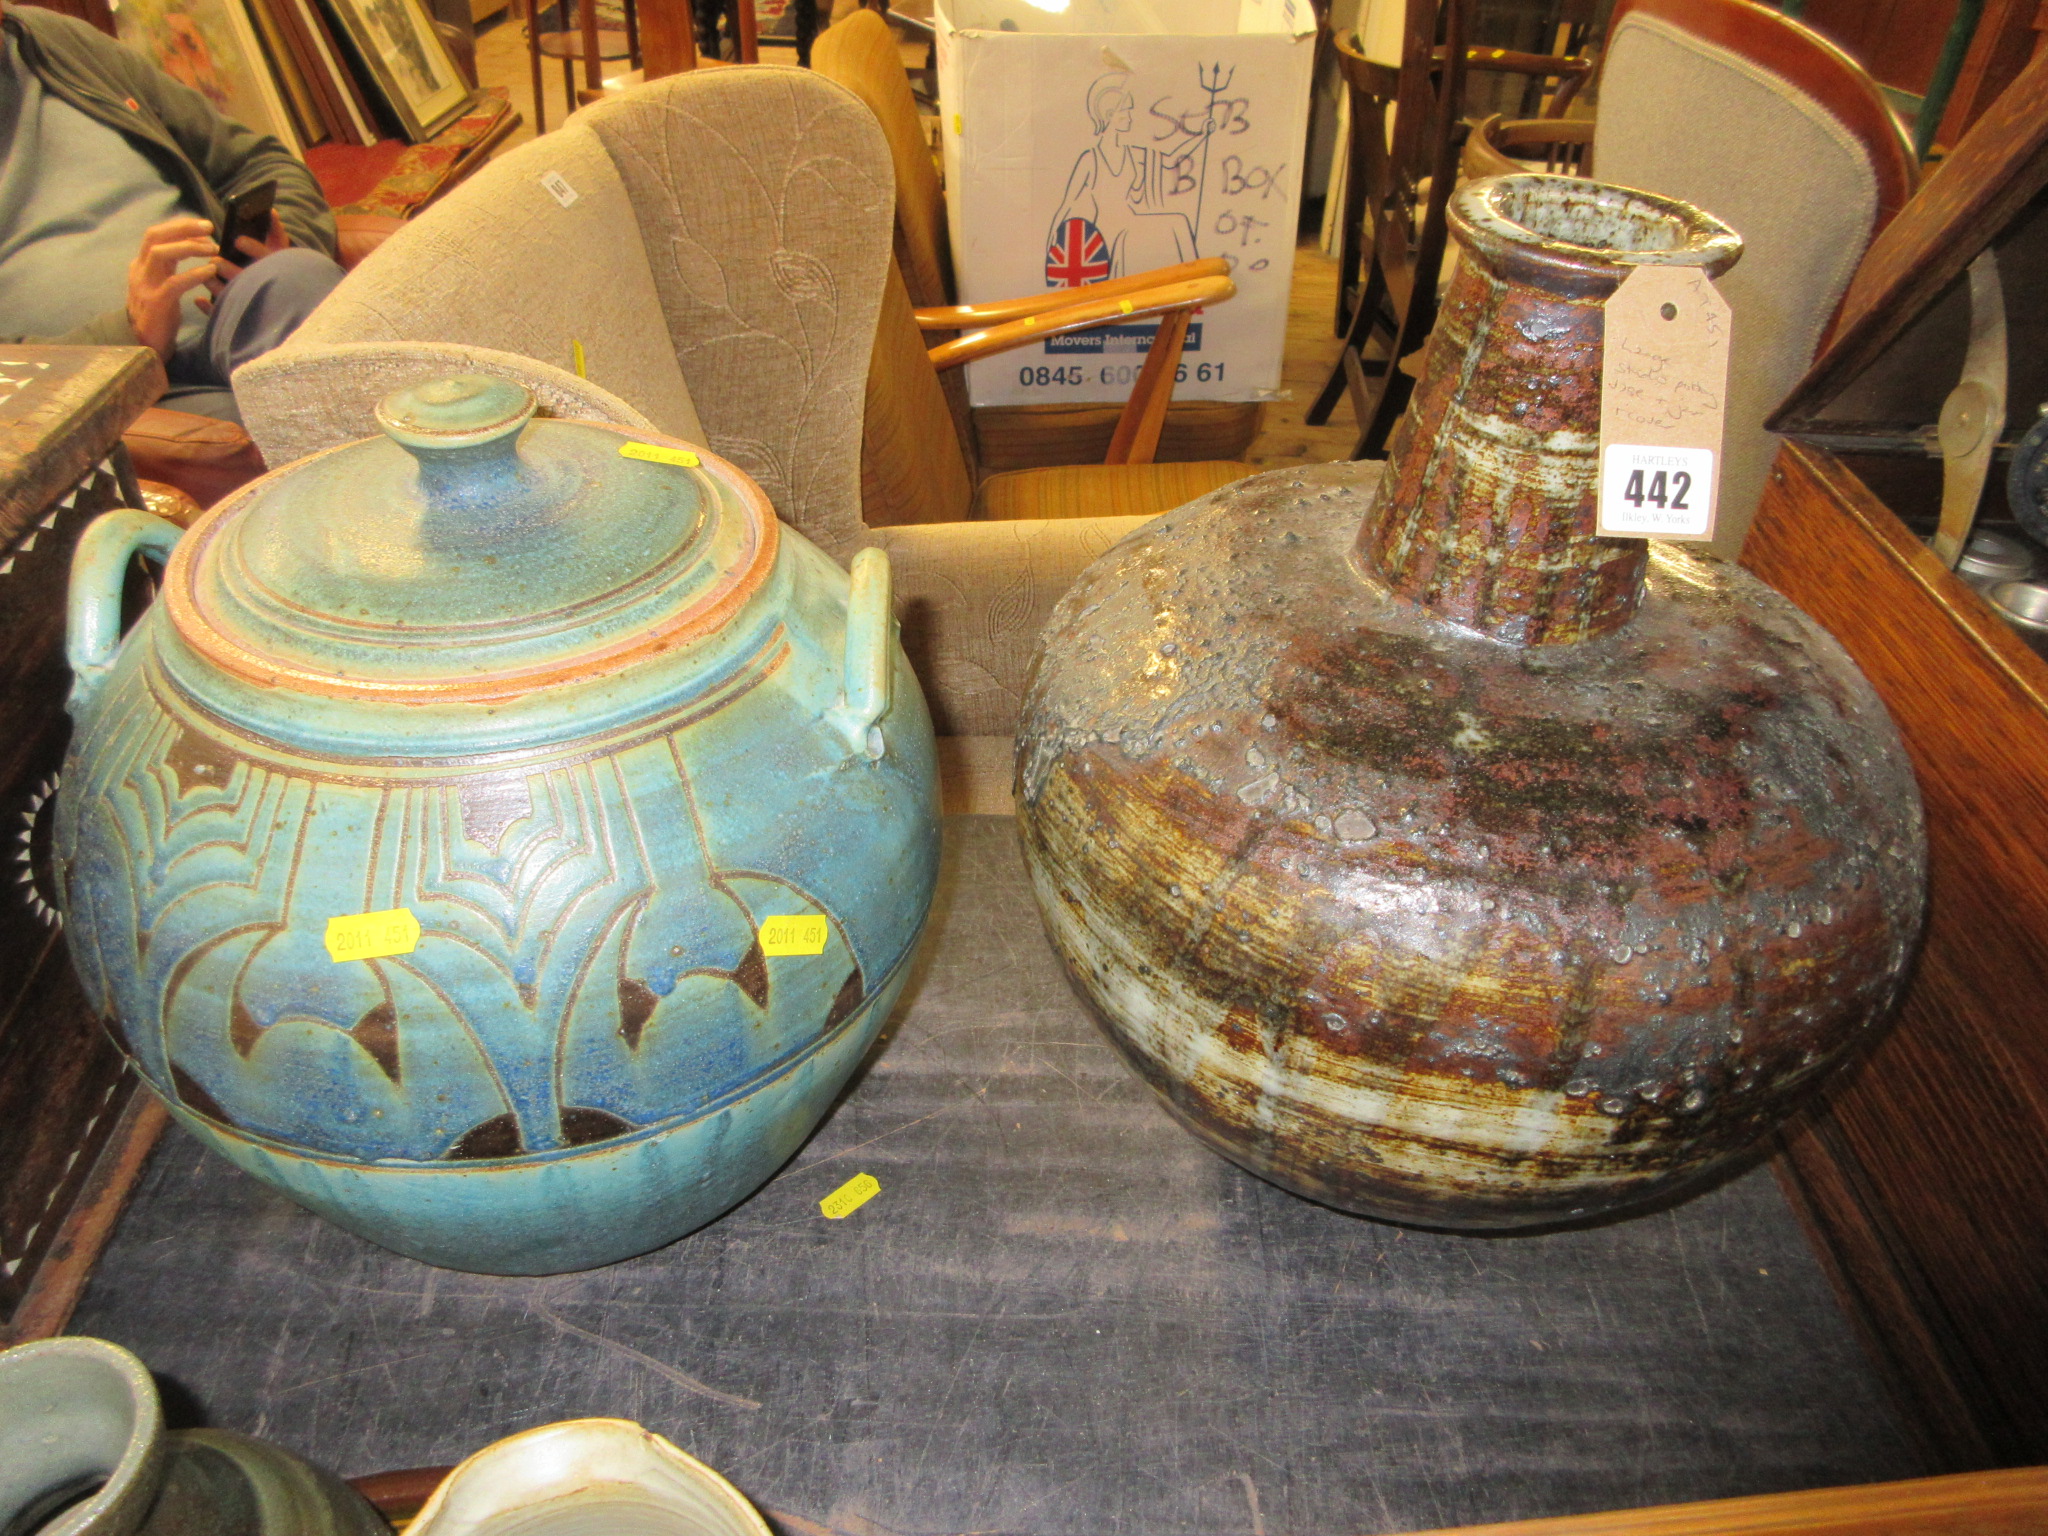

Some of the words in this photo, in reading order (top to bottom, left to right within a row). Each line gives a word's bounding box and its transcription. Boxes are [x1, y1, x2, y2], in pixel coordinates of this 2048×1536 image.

[1051, 335, 1102, 347] Movers
[1019, 366, 1083, 386] 0845
[1197, 362, 1225, 382] 61
[1632, 454, 1689, 467] HARTLEYS
[1624, 469, 1692, 510] 442
[1666, 513, 1691, 525] Yorks
[335, 929, 372, 951] 2011
[384, 924, 409, 944] 451
[768, 927, 795, 945] 2011
[803, 927, 821, 944] 451
